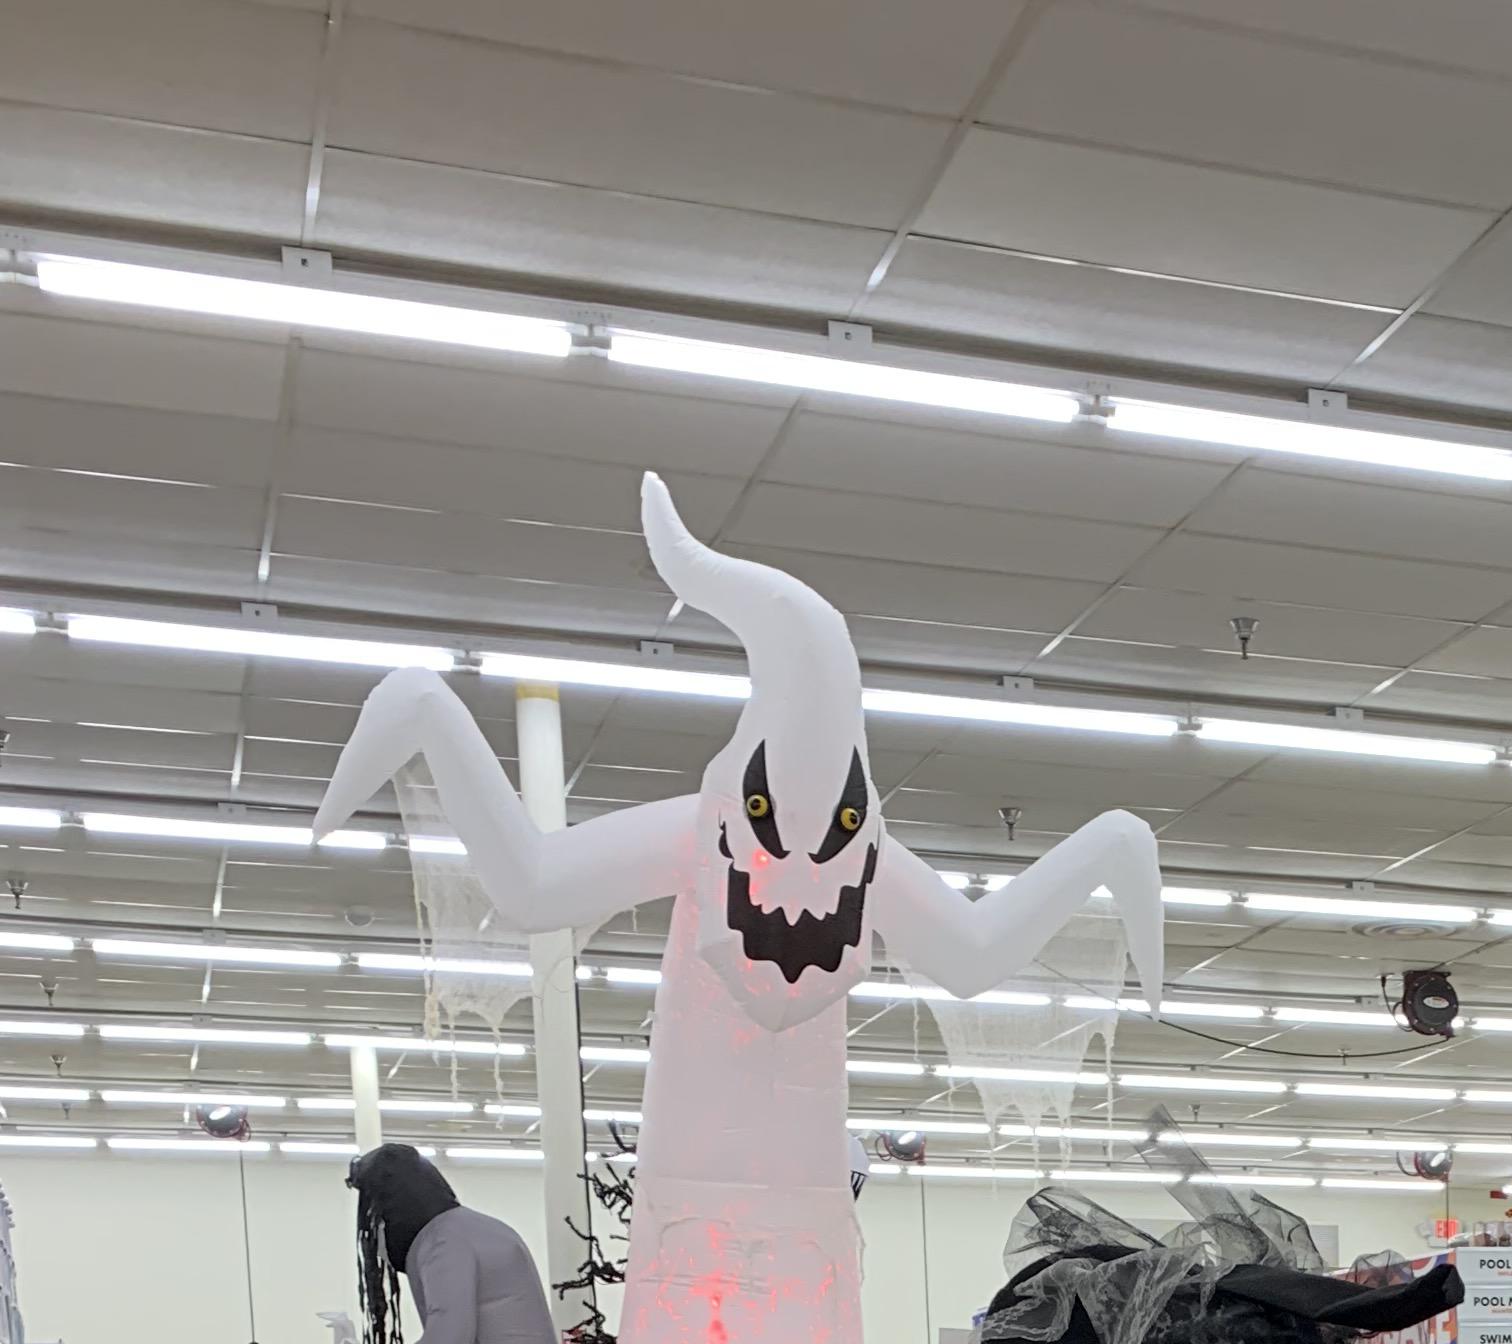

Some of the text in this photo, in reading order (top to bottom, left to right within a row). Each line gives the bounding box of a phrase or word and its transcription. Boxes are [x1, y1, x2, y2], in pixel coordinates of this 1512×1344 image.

[1479, 1259, 1512, 1269] POOL
[1473, 1297, 1506, 1307] POOL
[1480, 1334, 1512, 1344] SWIM
